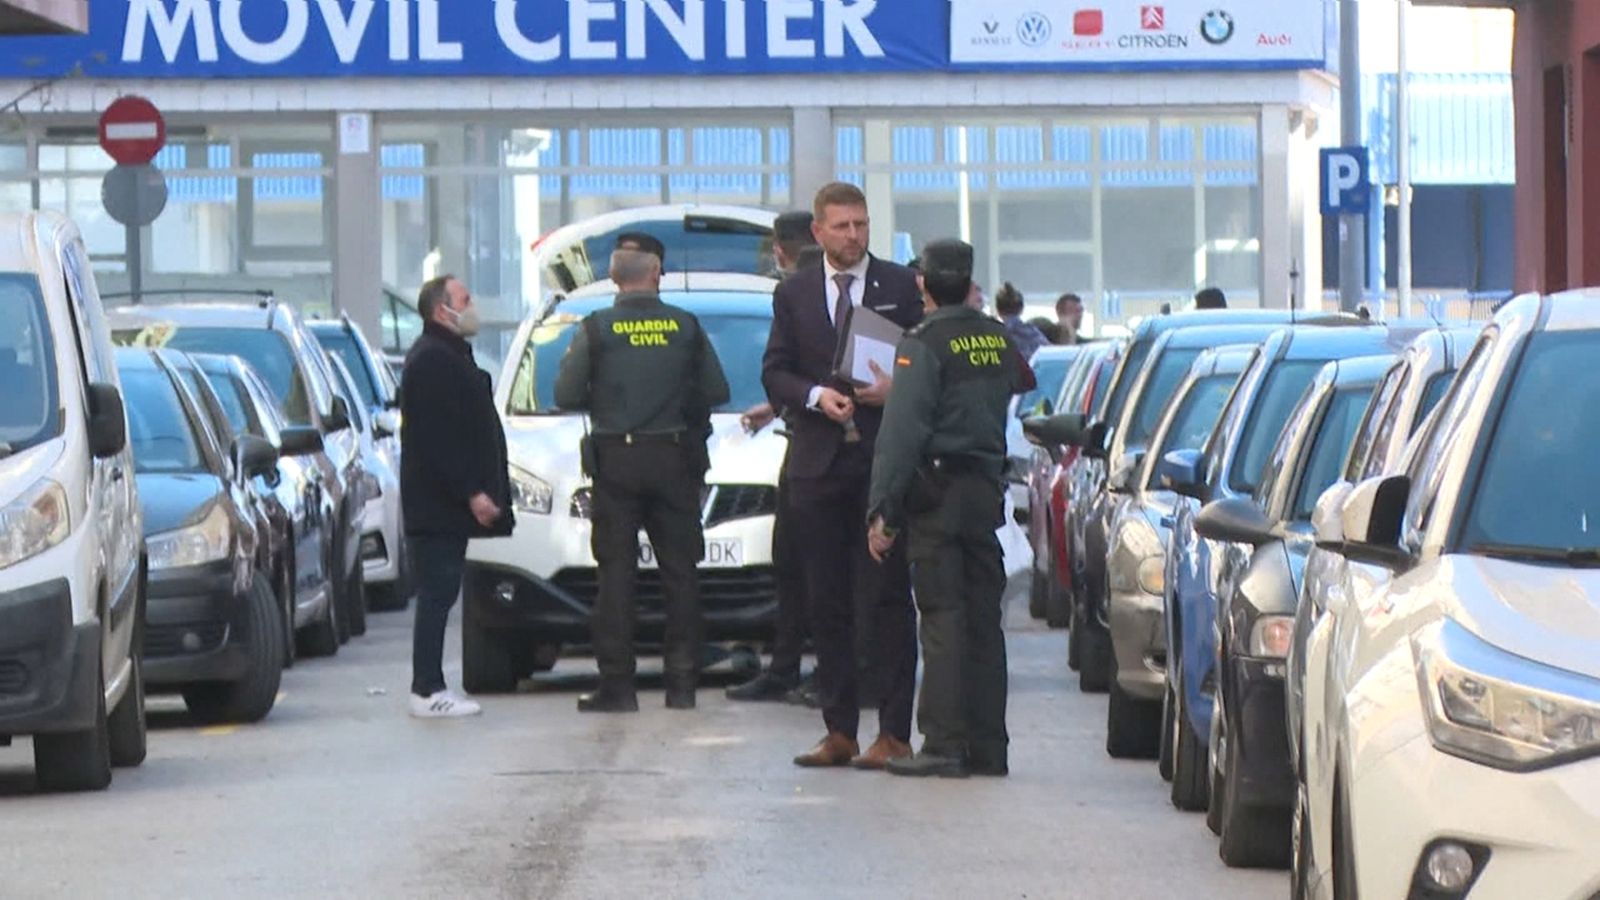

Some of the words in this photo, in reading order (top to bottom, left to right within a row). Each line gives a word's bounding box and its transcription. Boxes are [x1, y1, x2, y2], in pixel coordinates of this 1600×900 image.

[121, 0, 463, 64] MOVIL
[1256, 33, 1292, 45] Audi
[1328, 153, 1360, 207] P
[612, 319, 679, 333] GUARDIA
[629, 333, 669, 346] CIVIL
[949, 335, 1007, 354] GUARDIA
[969, 350, 1001, 366] CIVIL
